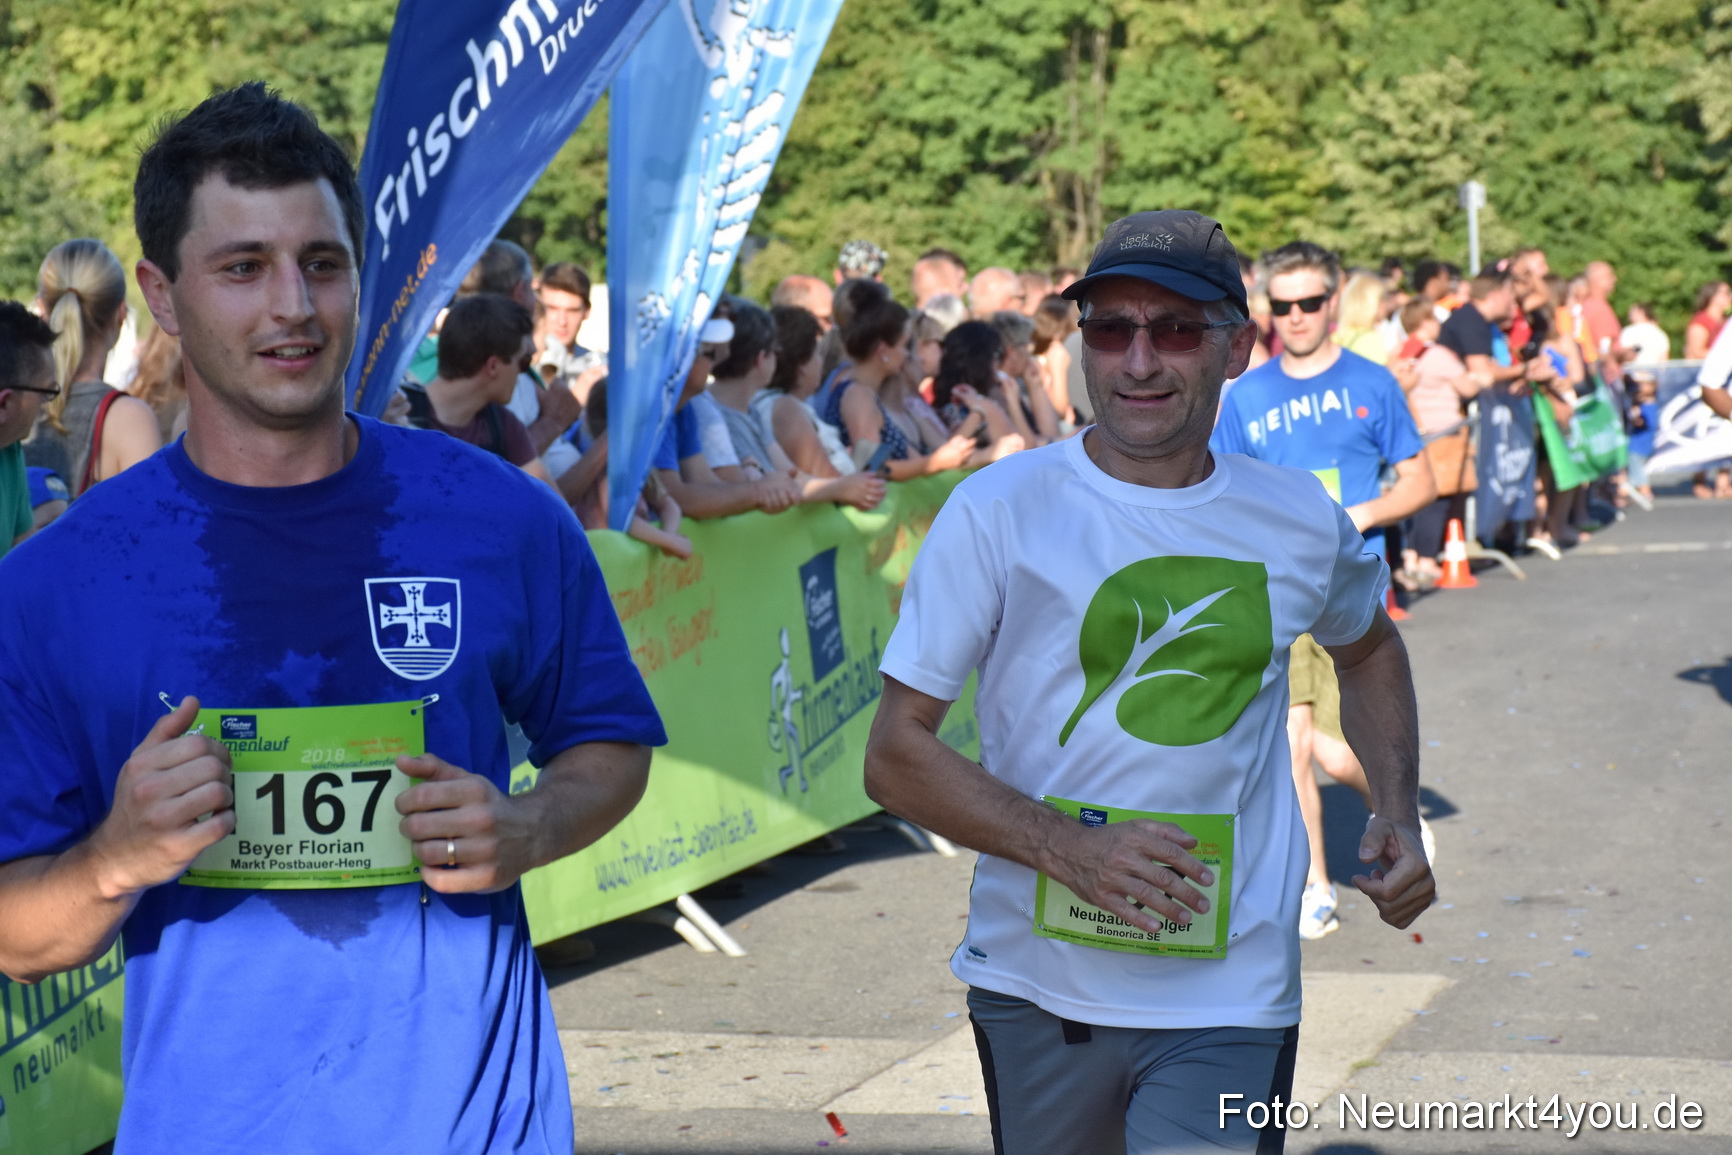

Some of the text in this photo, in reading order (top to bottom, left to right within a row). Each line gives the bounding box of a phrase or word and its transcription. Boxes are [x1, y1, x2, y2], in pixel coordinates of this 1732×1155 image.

[1125, 233, 1150, 245] Jack
[209, 736, 291, 752] menlauf
[301, 748, 346, 763] 2018
[230, 770, 391, 836] 167
[238, 838, 364, 858] Beyer Florian
[230, 857, 371, 871] Markt Postbauer-Heng
[1096, 926, 1144, 939] Bionorica
[1146, 932, 1161, 941] SE
[13, 998, 105, 1094] neumarkt
